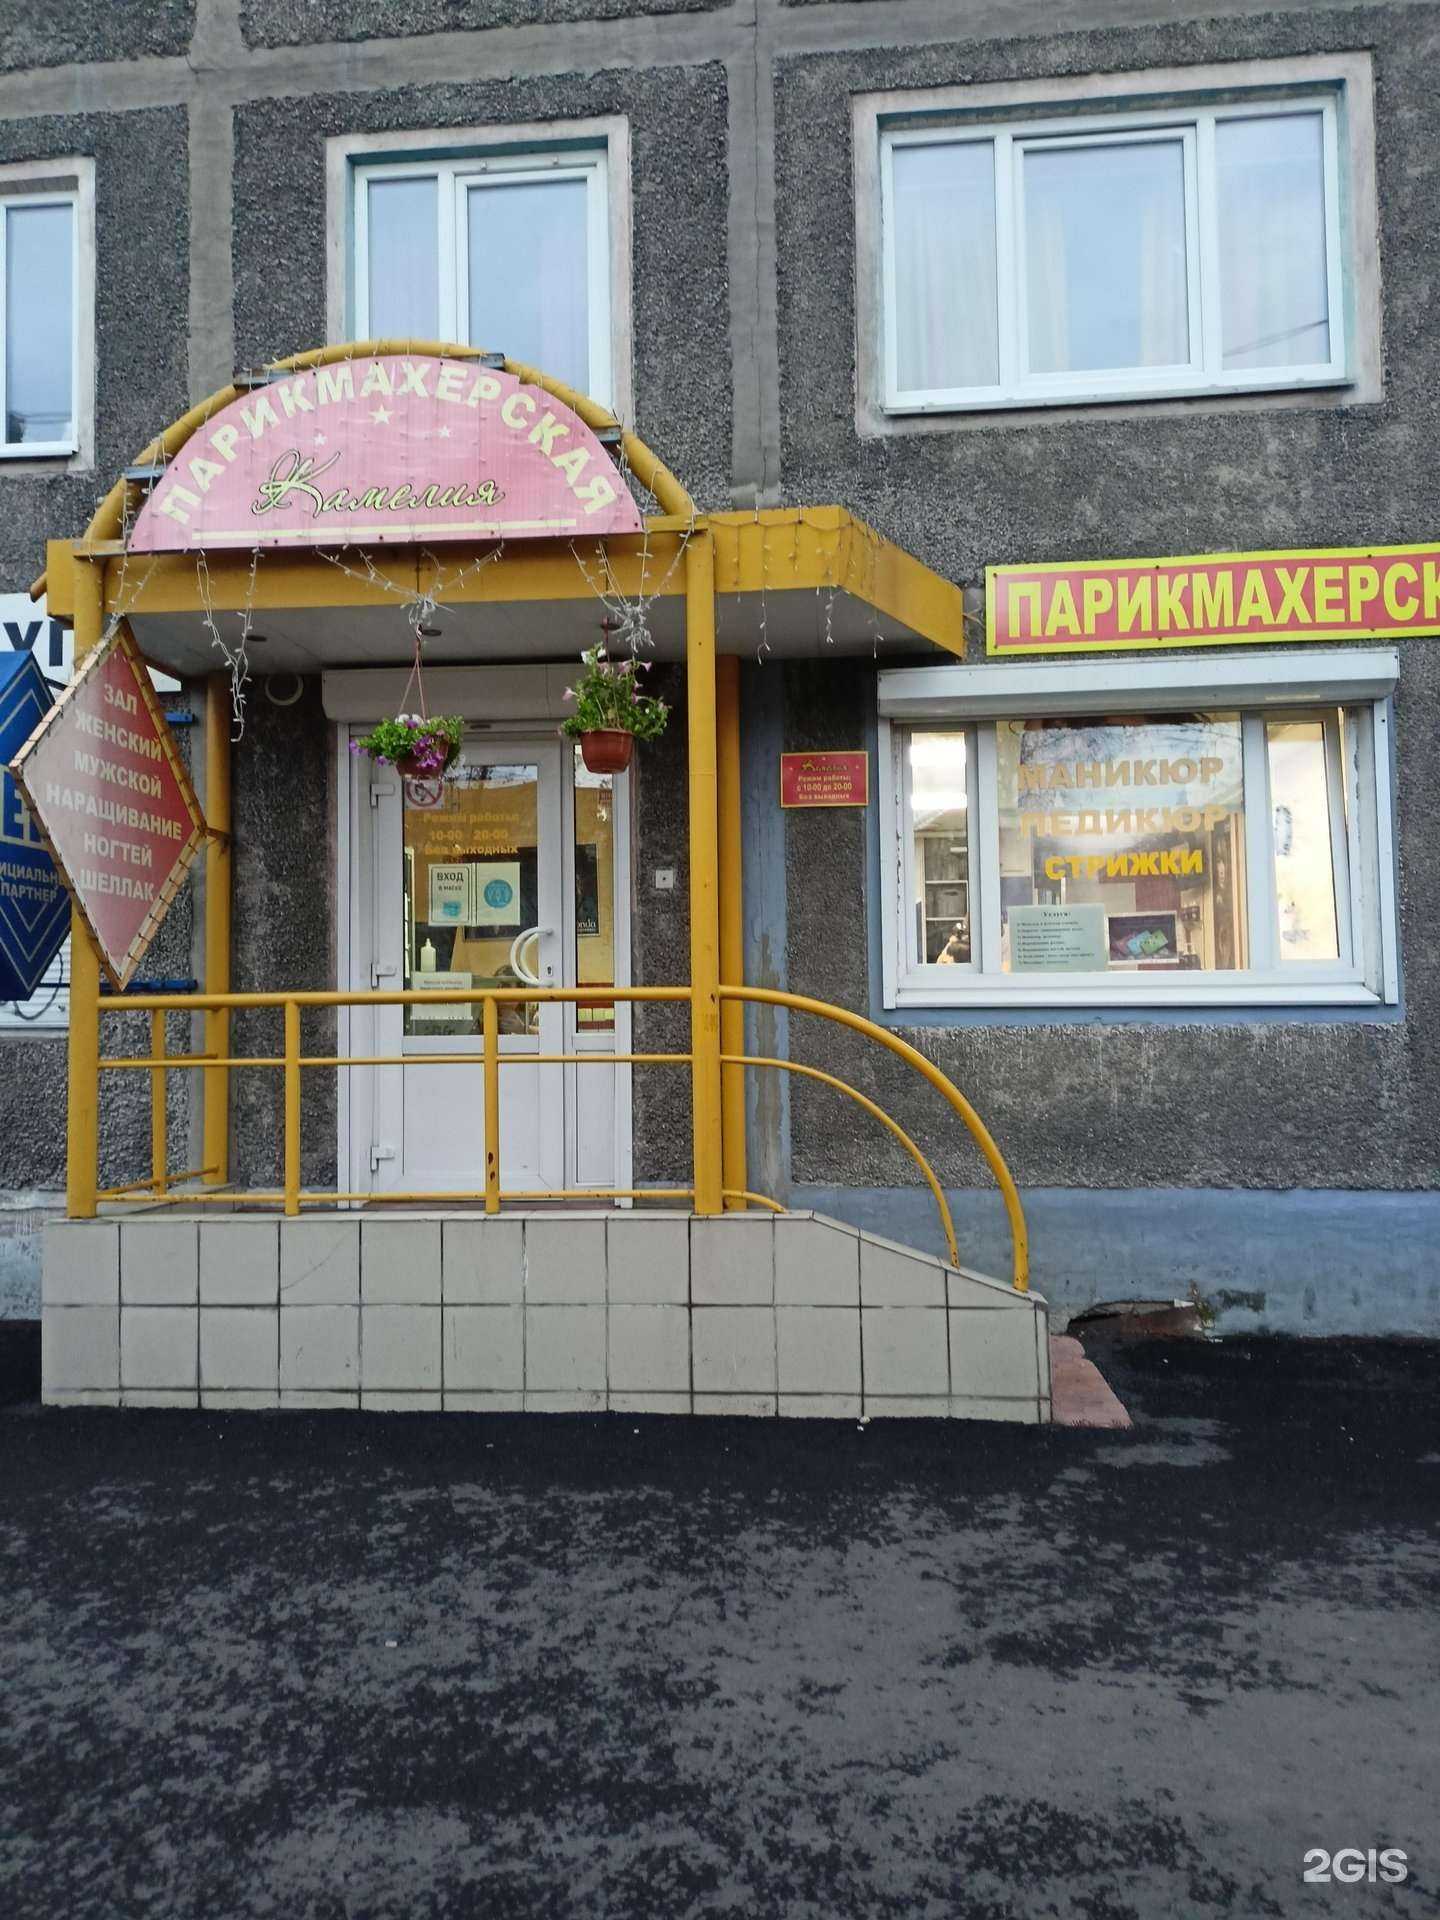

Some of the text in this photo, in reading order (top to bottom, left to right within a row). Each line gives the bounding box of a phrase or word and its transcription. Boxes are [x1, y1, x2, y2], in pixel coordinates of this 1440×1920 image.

[159, 361, 616, 525] ПАРИКМАХЕРСКАЯ
[250, 447, 506, 518] Камелия
[103, 684, 138, 716] ЗАЛ
[75, 708, 163, 762] ЖЕНСКИЙ
[73, 750, 163, 799] МУЖСКОЙ
[1017, 757, 1224, 791] МАНИКЮР
[45, 783, 182, 840] НАРАЩИВАНИЕ
[1019, 804, 1228, 838] ПЕДИКЮР
[83, 832, 153, 868] НОГТЕЙ
[1044, 850, 1203, 881] СТРИЖКИ
[0, 881, 57, 904] ПАРТНЕР
[80, 868, 155, 901] ШЕЛЛАК
[437, 872, 464, 882] ВХОД
